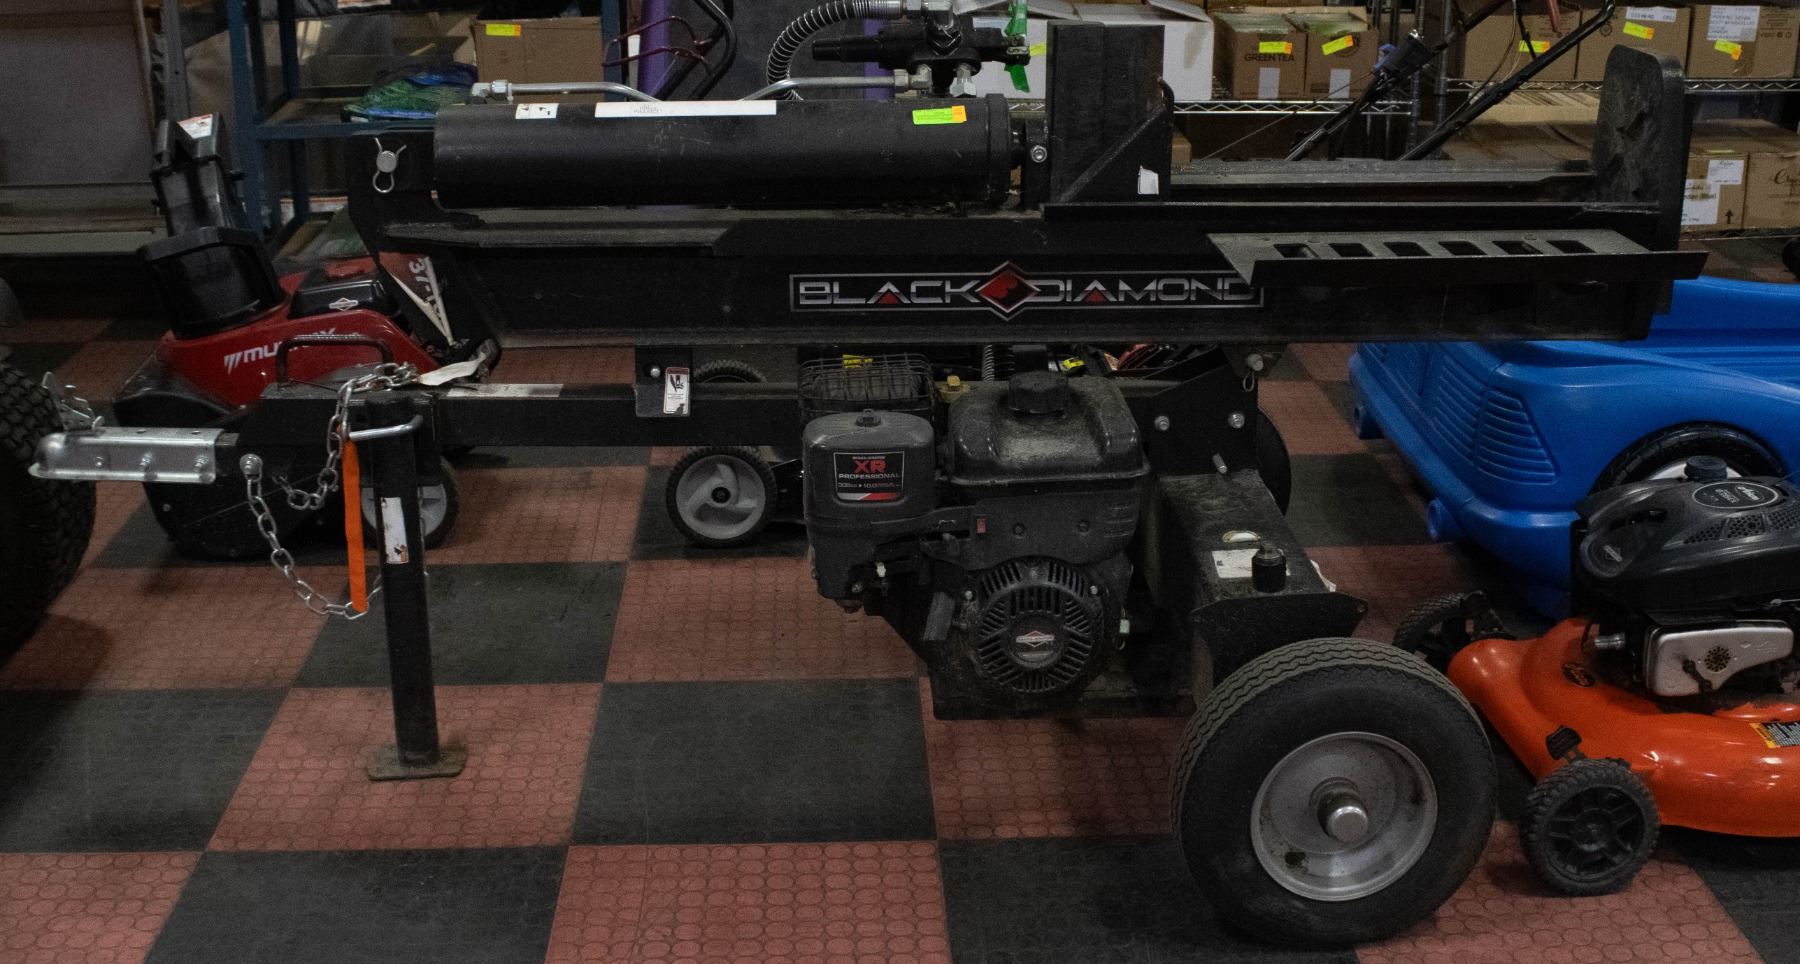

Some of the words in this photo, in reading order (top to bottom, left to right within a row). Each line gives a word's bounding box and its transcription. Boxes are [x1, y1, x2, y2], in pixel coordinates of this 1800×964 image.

[1244, 53, 1275, 61] GREEN
[799, 280, 982, 305] BLACK
[1022, 277, 1255, 303] DIAMOND
[853, 459, 887, 474] XR
